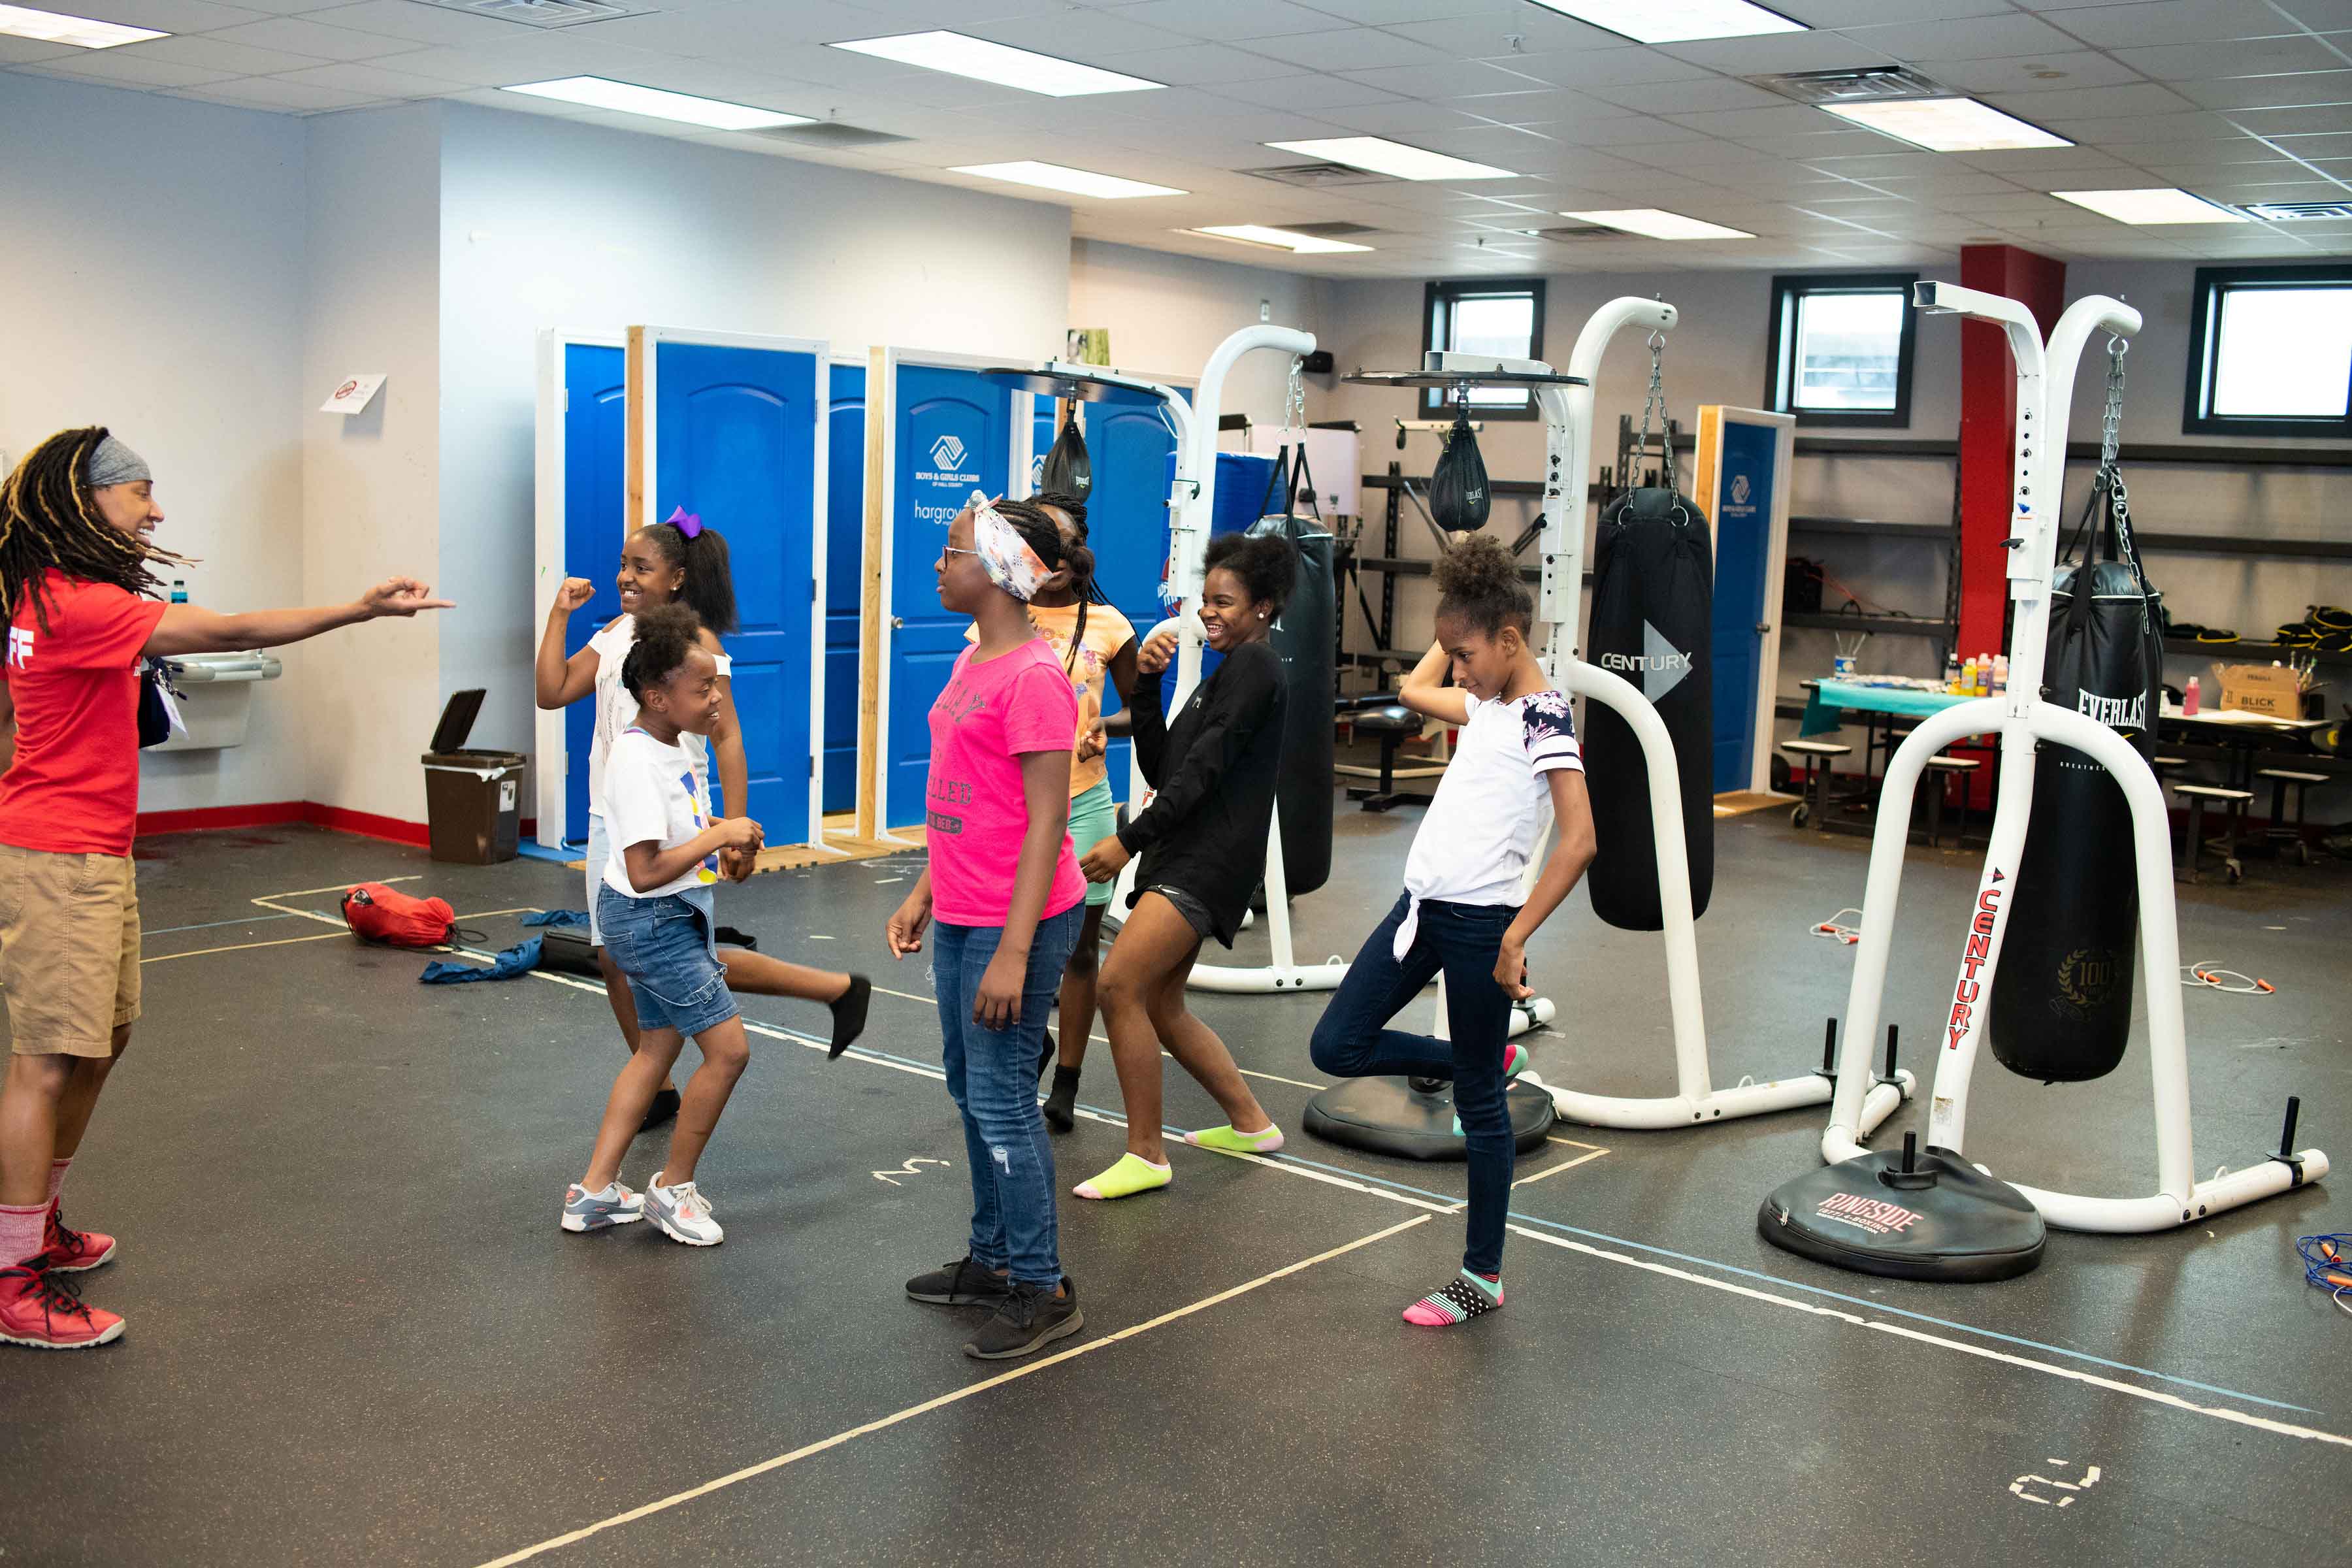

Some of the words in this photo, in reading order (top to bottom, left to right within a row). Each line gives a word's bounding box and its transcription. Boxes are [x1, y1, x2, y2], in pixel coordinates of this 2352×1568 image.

[915, 498, 966, 525] hargrov
[1601, 651, 1692, 672] CENTURY
[2078, 687, 2148, 732] EVERLAST
[2242, 696, 2276, 707] BLICK
[1948, 889, 2001, 1050] CENTURY
[1818, 1192, 1924, 1233] RINGSIDE
